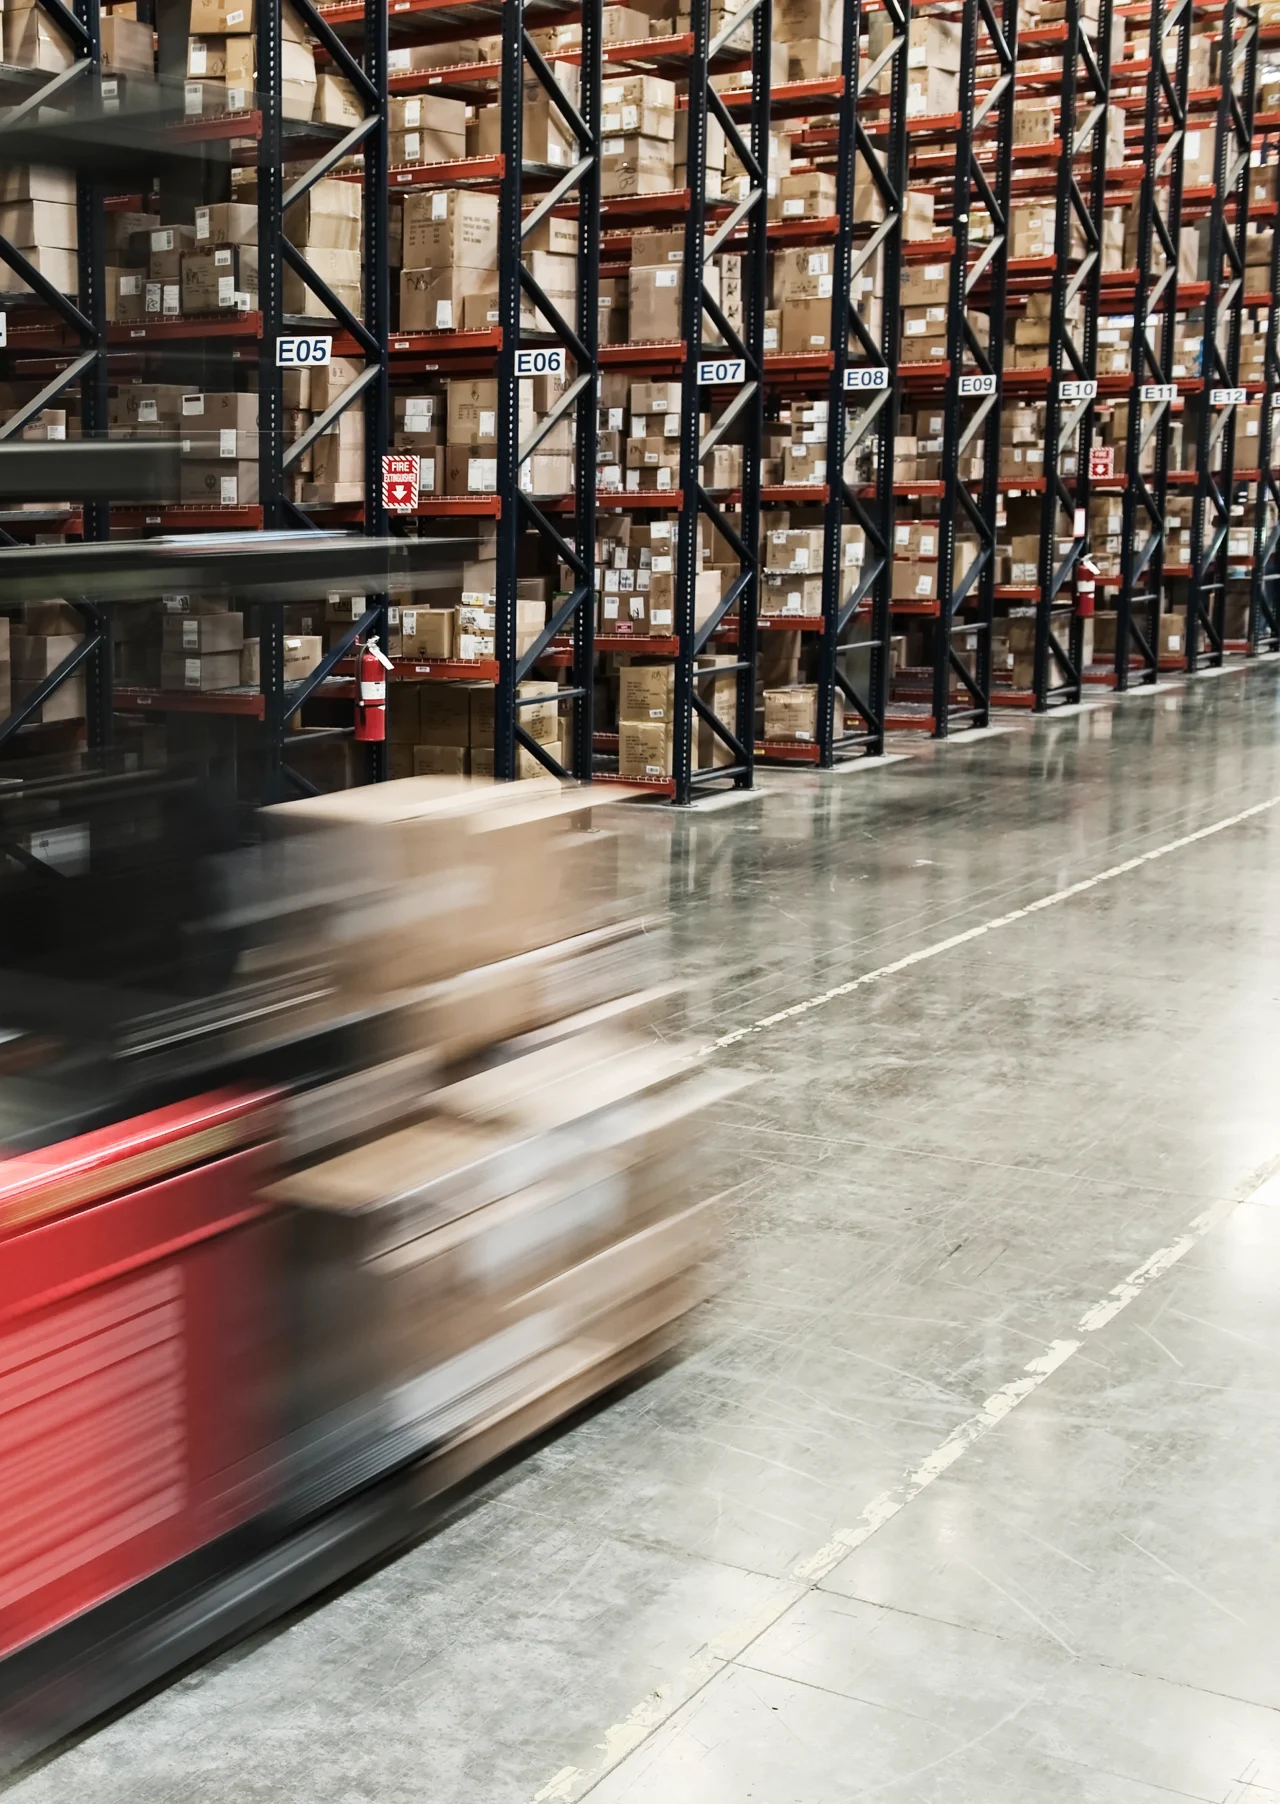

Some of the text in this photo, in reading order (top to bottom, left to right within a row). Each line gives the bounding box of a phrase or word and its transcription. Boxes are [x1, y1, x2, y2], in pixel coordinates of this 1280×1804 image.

[279, 339, 326, 362] E05
[517, 351, 561, 372] E06
[701, 363, 741, 381] E07
[847, 370, 884, 386] E08
[961, 377, 992, 392] E09
[1062, 383, 1093, 396] E10
[1145, 387, 1173, 399] E11
[1213, 390, 1243, 402] E12
[391, 461, 410, 472] FIRE
